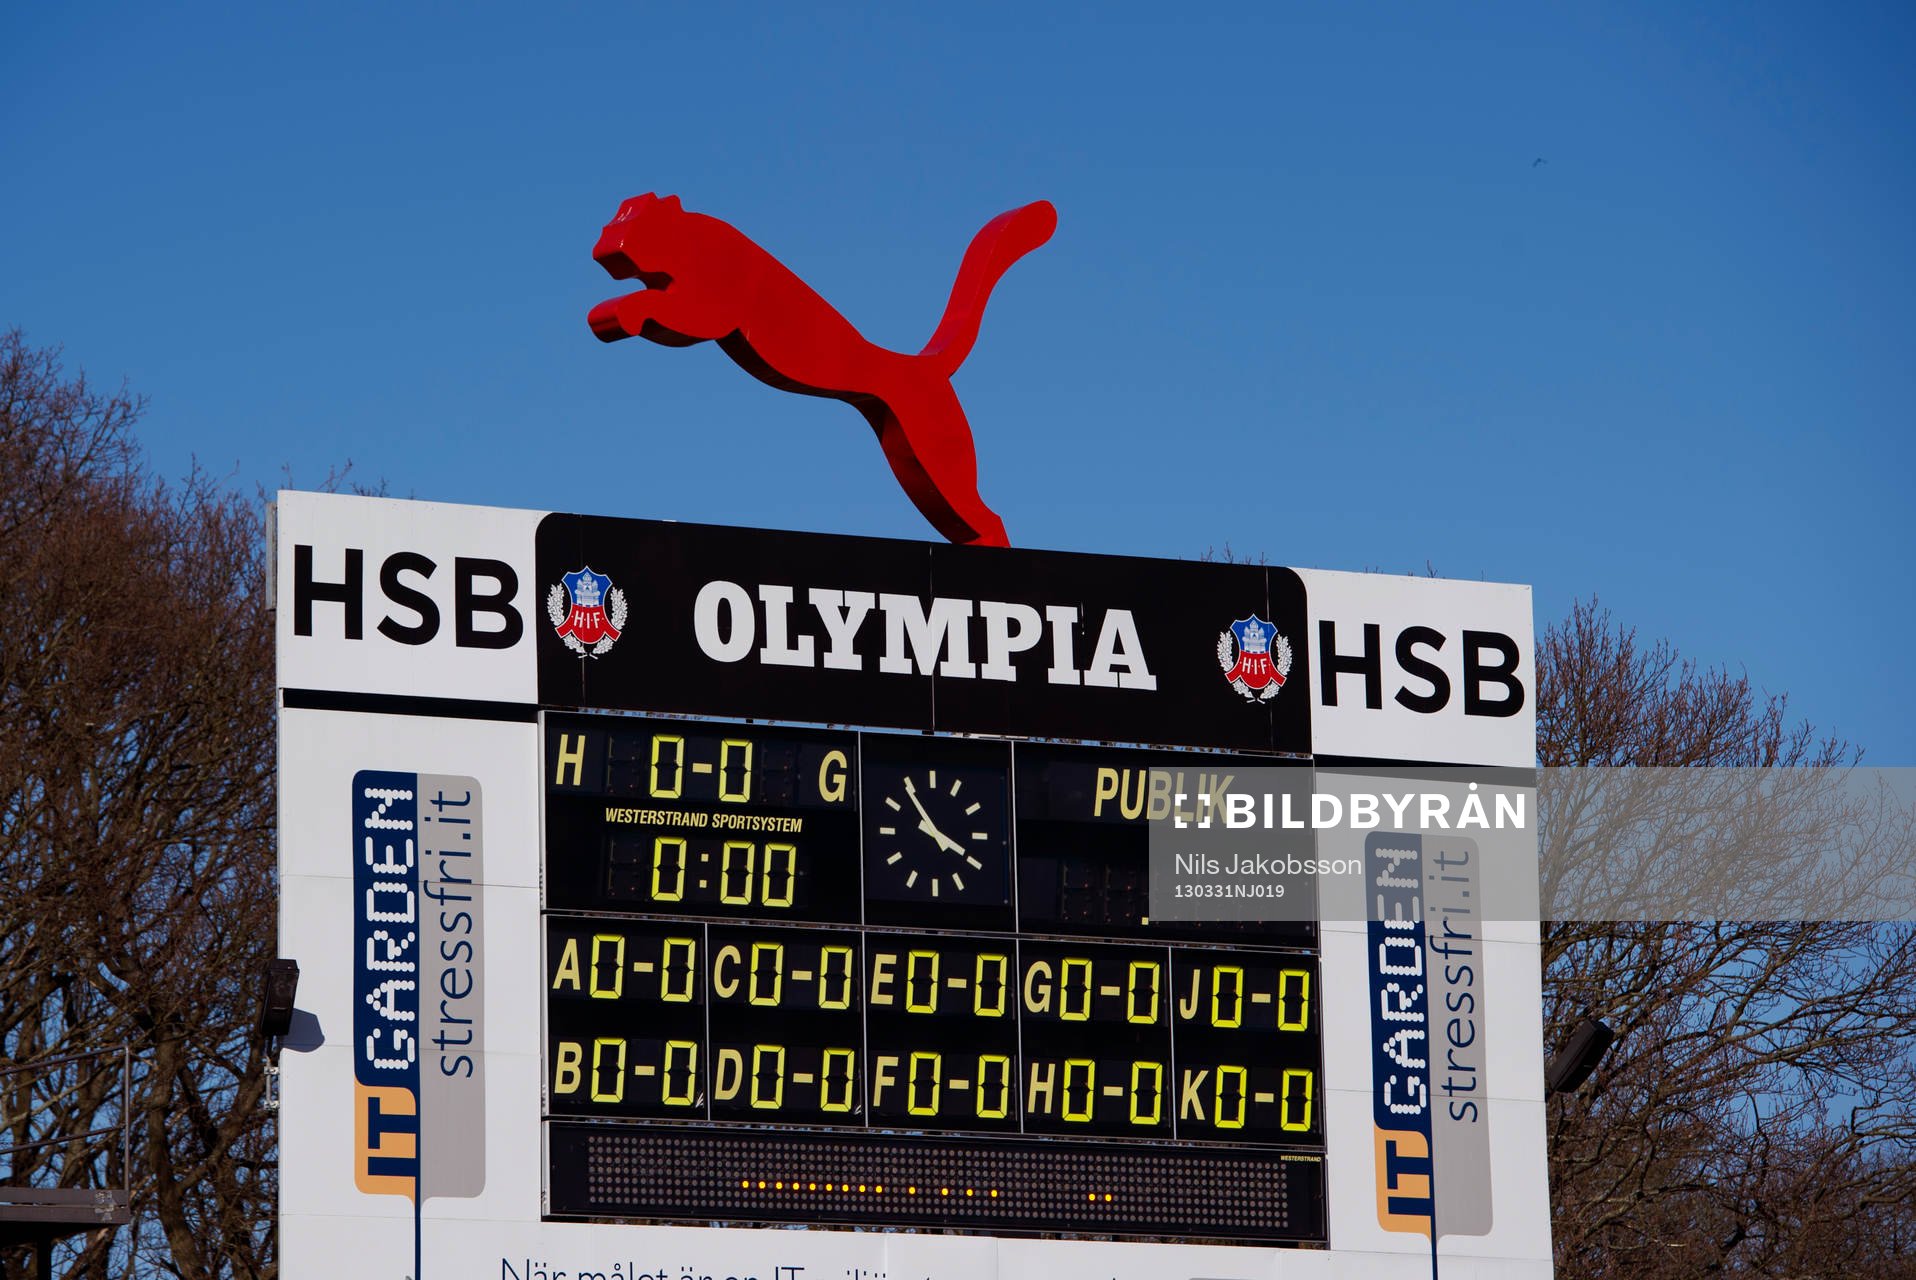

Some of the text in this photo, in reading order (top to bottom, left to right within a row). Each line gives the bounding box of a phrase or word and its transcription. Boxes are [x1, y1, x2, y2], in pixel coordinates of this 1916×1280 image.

[293, 544, 524, 650] HSB
[693, 580, 1157, 691] OLYMPIA
[1318, 619, 1525, 718] HSB
[556, 734, 586, 786] H
[818, 750, 848, 802] G
[605, 807, 803, 833] WESTERSTRAND SPORTSYSTEM
[1093, 767, 1236, 824] PUBLIK
[651, 837, 797, 908] 0:00
[365, 786, 416, 1177] IT GARDEN
[424, 790, 474, 1079] stressfri.it
[1429, 850, 1479, 1124] stressfri.it
[1375, 847, 1432, 1217] IT GARDEN
